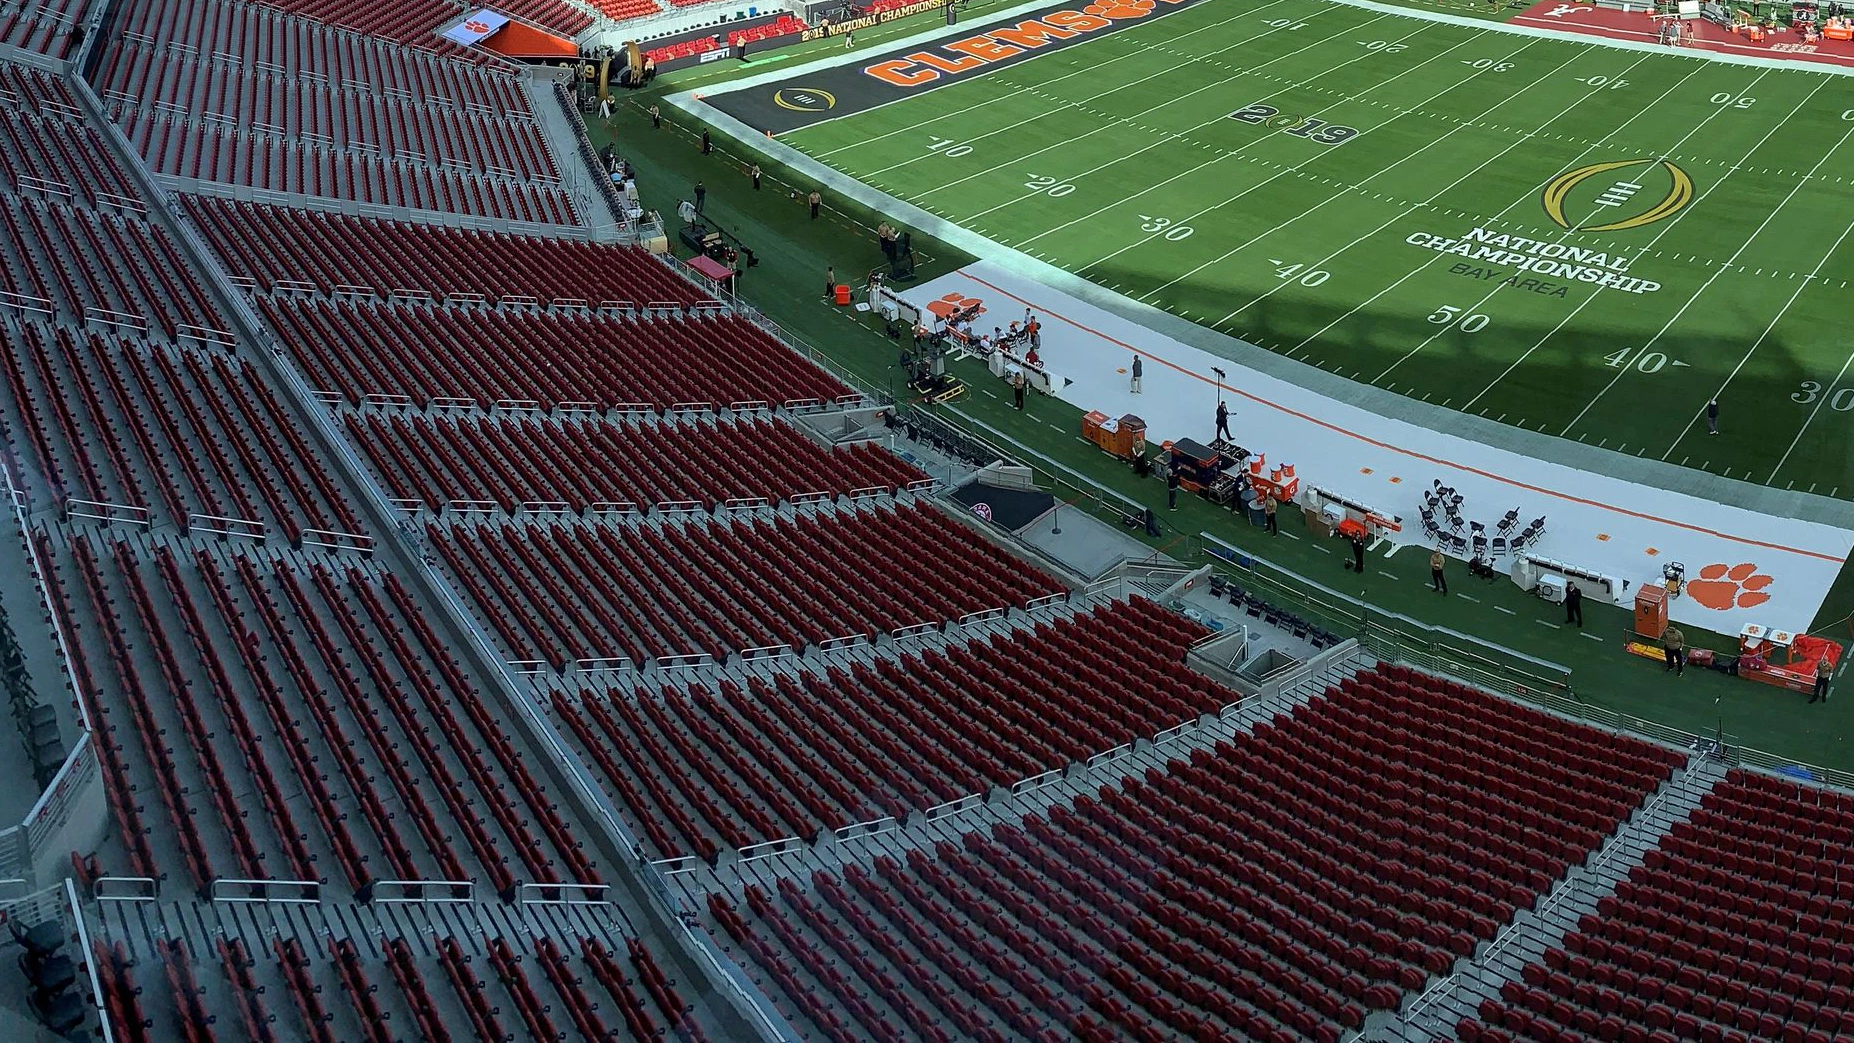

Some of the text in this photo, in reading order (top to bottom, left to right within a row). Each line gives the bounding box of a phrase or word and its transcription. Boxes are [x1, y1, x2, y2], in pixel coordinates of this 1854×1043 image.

[700, 47, 730, 64] ESPN
[1709, 92, 1756, 108] 50
[1228, 104, 1360, 146] 2019
[926, 139, 974, 158] 10
[1024, 176, 1076, 198] 20
[1140, 217, 1194, 241] 30
[1461, 227, 1630, 272] NATIONAL
[1274, 263, 1330, 287] 40
[1405, 232, 1662, 294] CHAMPIONSHIP
[1449, 262, 1570, 299] BAY AREA
[1427, 305, 1490, 333] 50
[1603, 347, 1668, 374] 40
